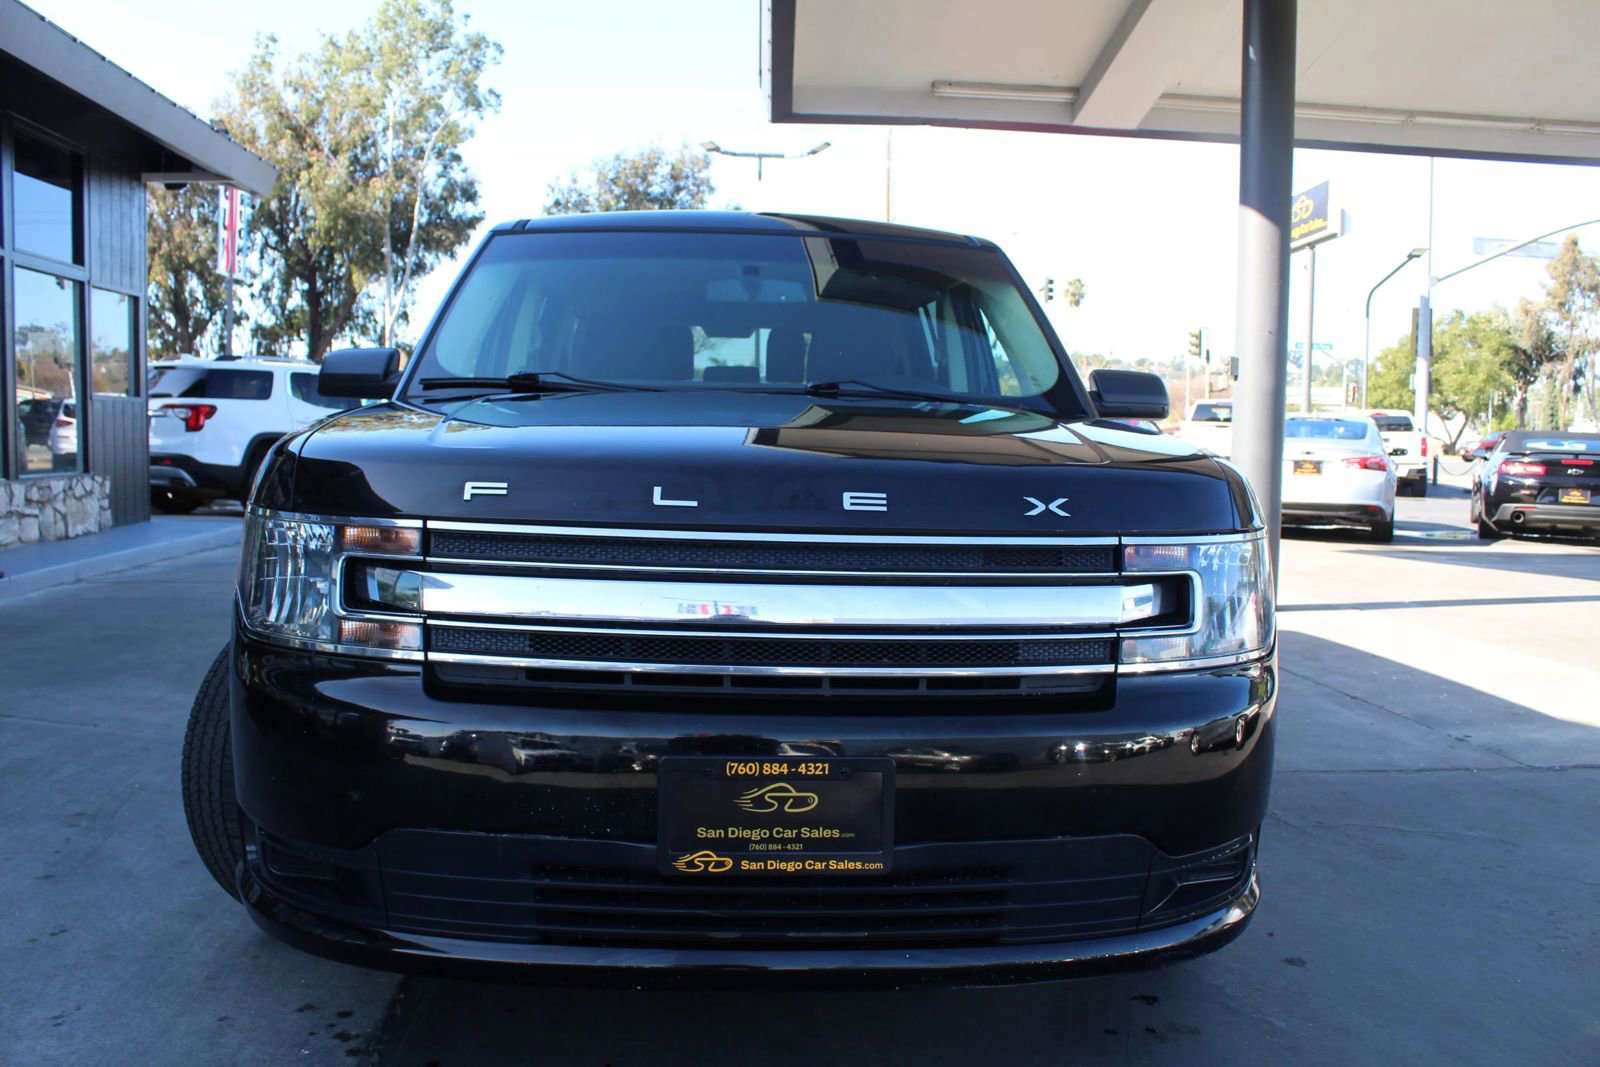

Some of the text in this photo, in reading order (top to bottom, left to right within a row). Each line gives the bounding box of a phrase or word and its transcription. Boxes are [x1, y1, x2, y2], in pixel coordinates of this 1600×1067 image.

[463, 481, 1071, 517] FLEX
[726, 761, 760, 777] (760)
[697, 827, 724, 838] San
[728, 827, 770, 840] Diego
[772, 827, 798, 838] Car
[749, 843, 767, 851] (760)
[740, 860, 883, 872] San Diego Car Sales.com
